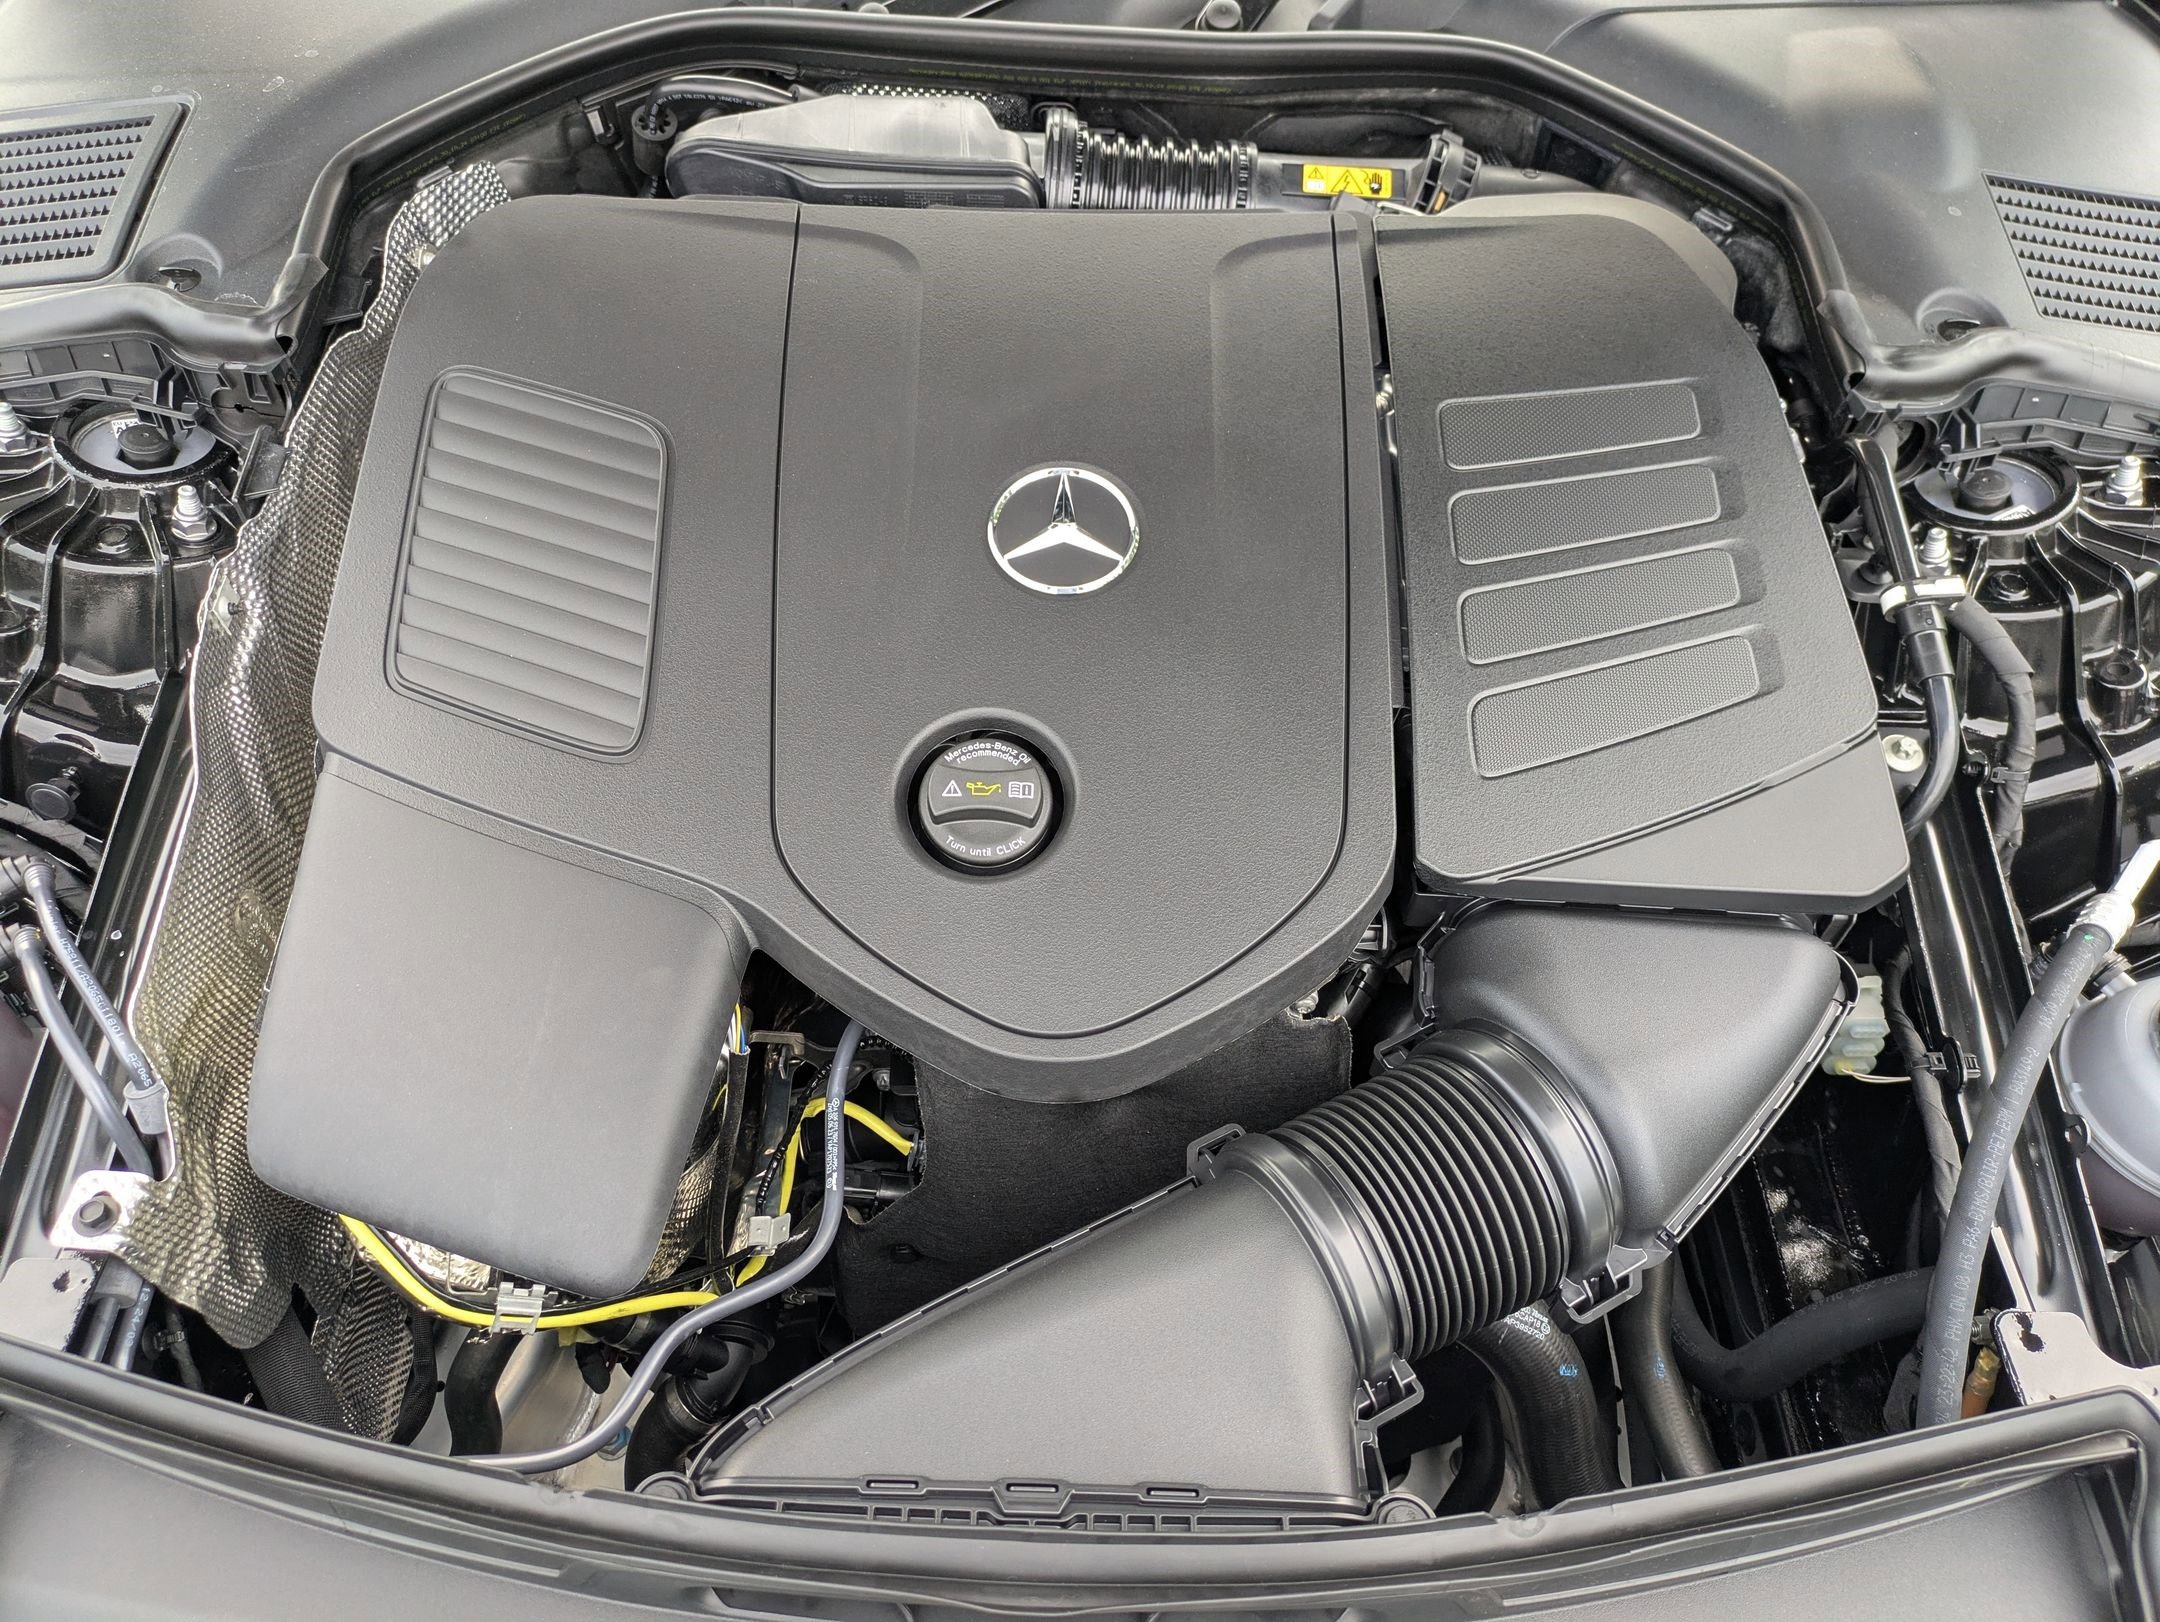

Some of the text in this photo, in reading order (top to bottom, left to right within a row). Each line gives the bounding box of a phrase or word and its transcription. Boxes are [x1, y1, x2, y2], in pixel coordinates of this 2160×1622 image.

[944, 742, 1031, 764] Mercedes-Benz Oil
[956, 749, 1020, 766] recommended
[945, 835, 1026, 857] Turn until CLICK
[1500, 1317, 1545, 1340] AP3952720
